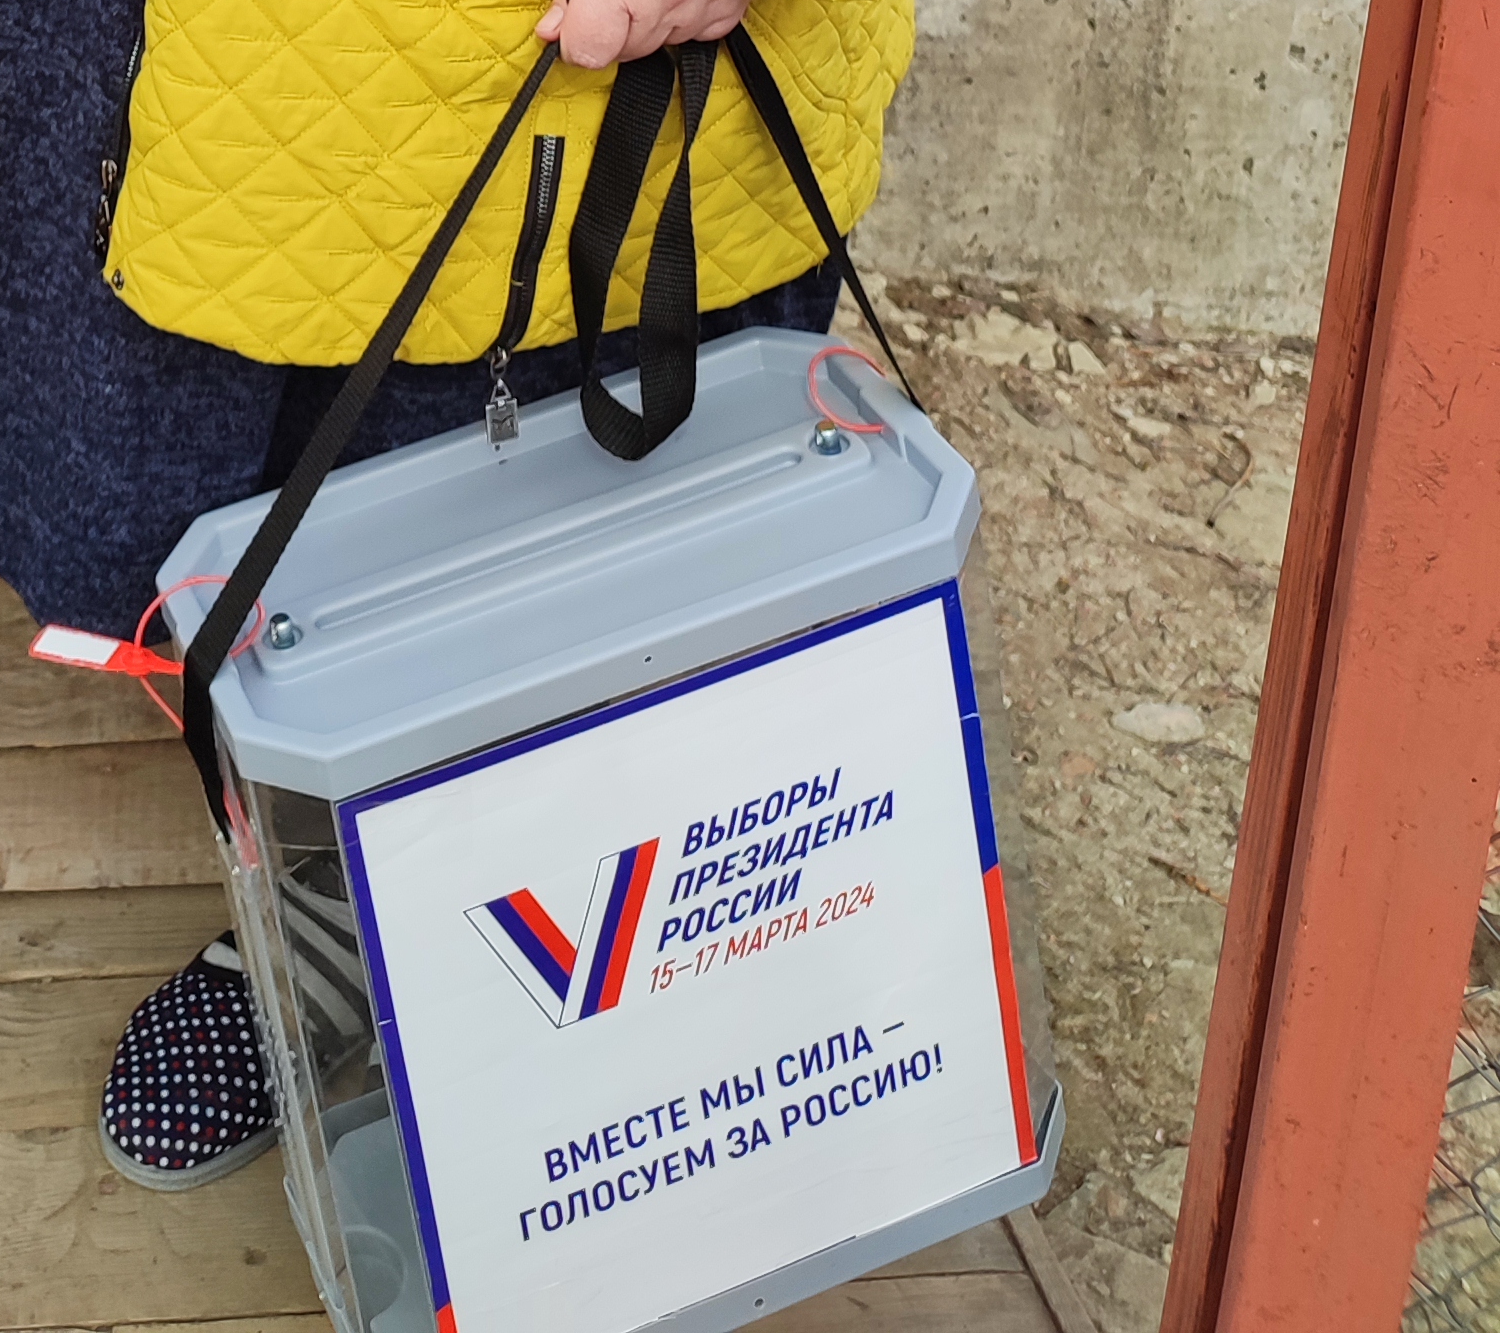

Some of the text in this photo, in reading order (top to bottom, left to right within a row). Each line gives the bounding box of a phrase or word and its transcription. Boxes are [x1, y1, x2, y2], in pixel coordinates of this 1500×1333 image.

[668, 789, 895, 906] ПРЕЗИДЕНТА
[681, 766, 841, 859] ВЫБОРЫ
[657, 868, 803, 954] РОССИИ
[723, 908, 810, 967] МАРТА
[815, 880, 875, 929] 2024
[518, 1042, 945, 1243] ГОЛОСУЕМ ЗА РОССИЮ!
[544, 1096, 691, 1184] ВМЕСТЕ
[699, 1065, 766, 1122] МЫ
[775, 1023, 874, 1090] СИЛА
